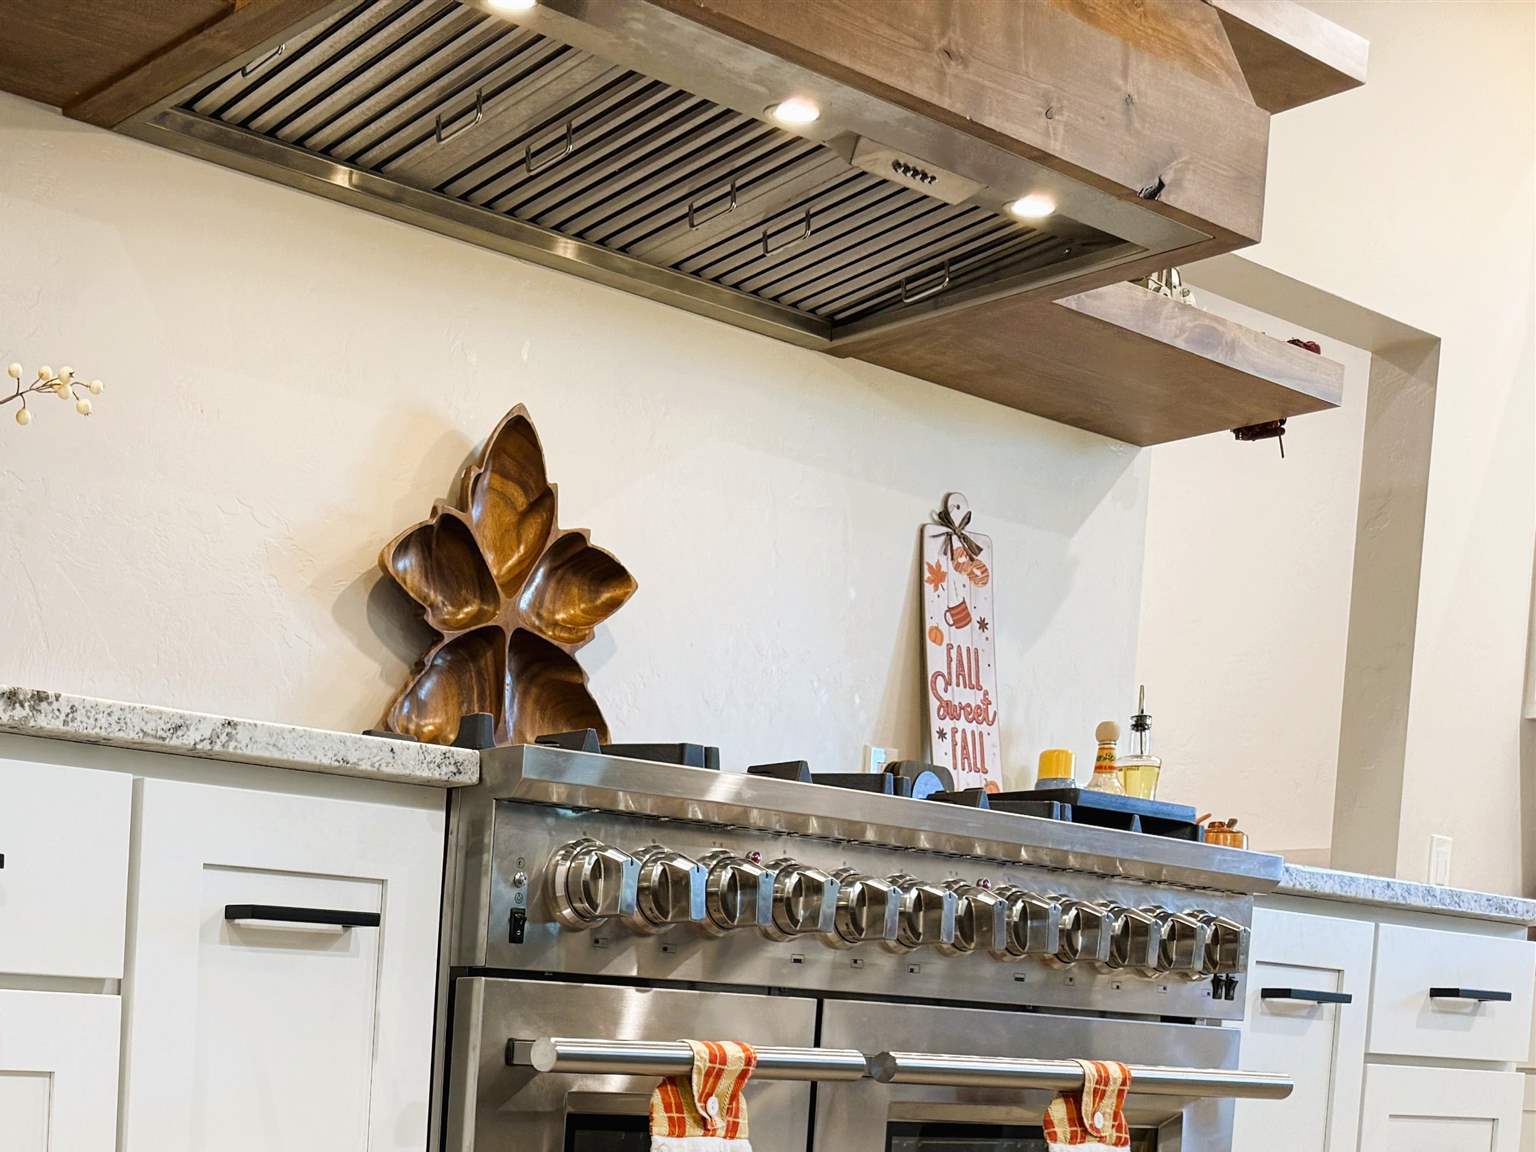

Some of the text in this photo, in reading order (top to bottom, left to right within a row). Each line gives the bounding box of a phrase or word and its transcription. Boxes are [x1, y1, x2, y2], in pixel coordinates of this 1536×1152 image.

[945, 643, 983, 691] FALL
[930, 671, 997, 726] Sweet
[951, 727, 989, 774] FALL
